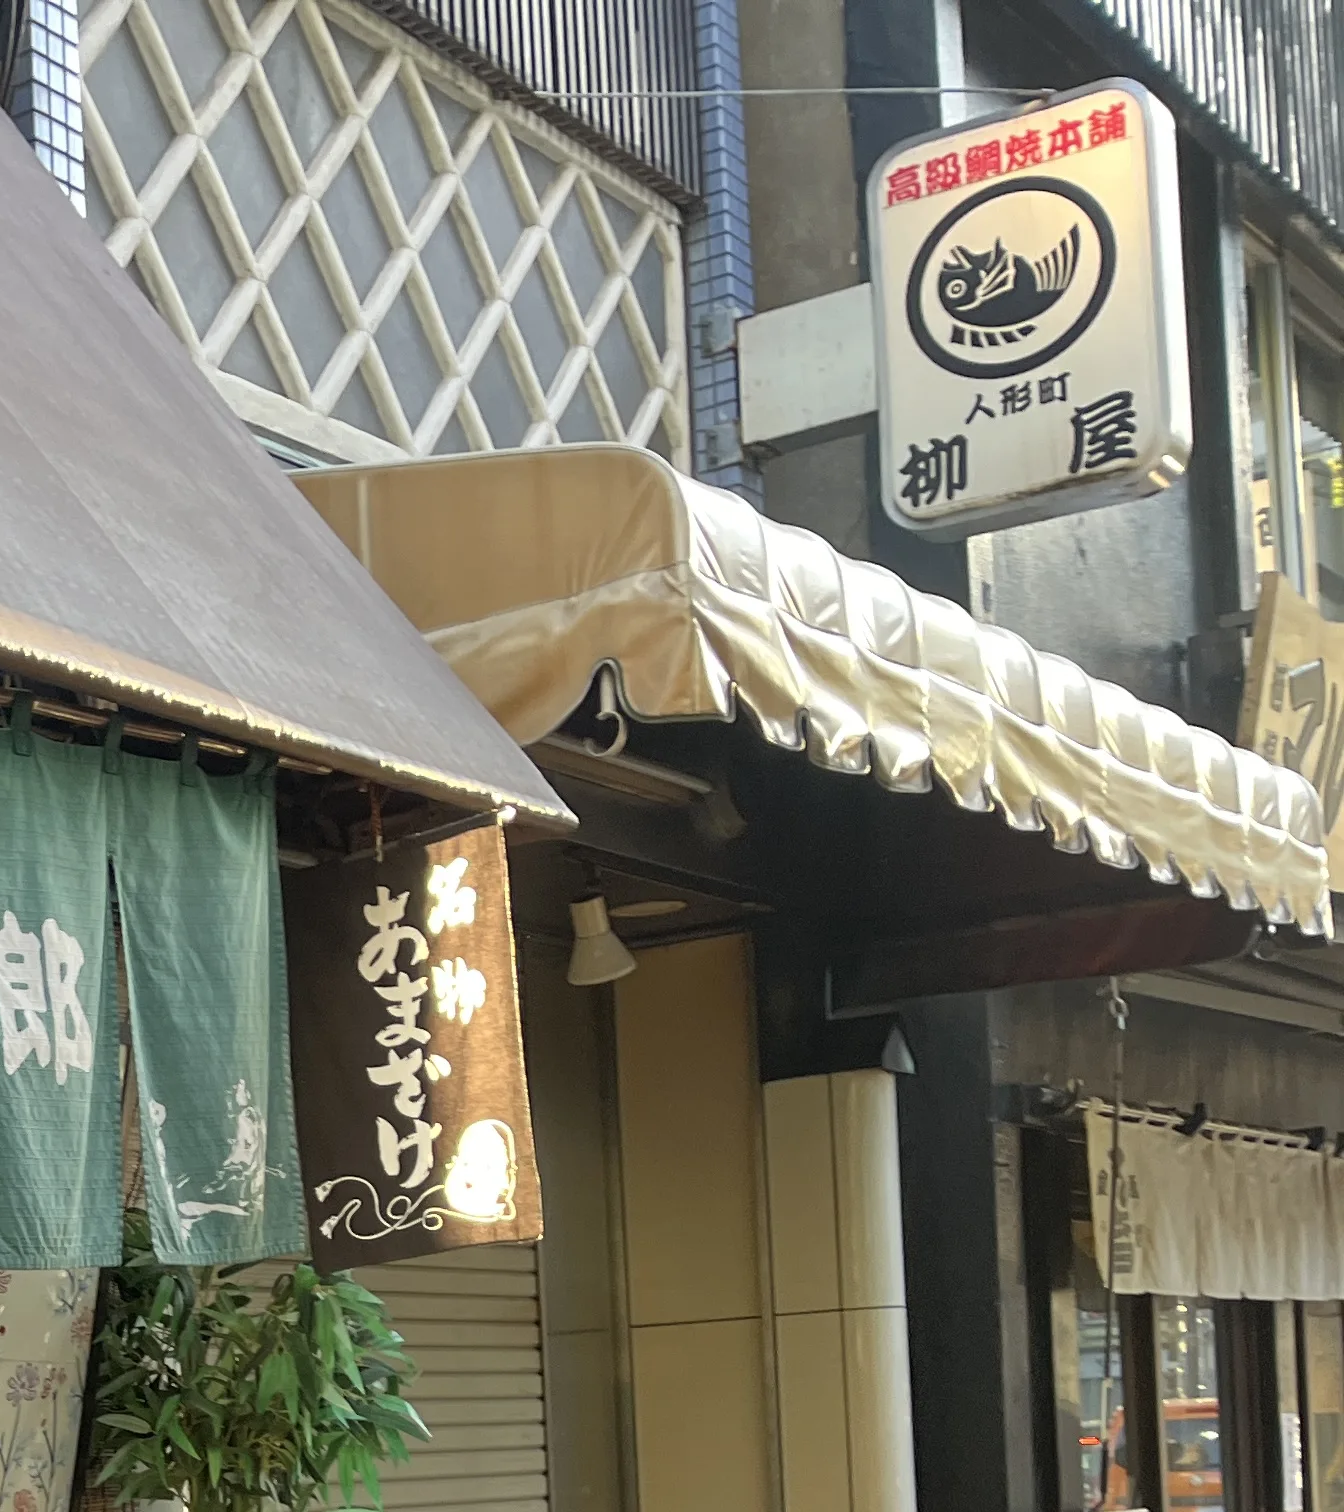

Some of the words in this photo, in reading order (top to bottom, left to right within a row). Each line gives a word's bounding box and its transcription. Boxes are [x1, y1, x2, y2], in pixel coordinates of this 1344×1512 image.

[965, 372, 1073, 424] 人形町
[427, 856, 487, 1024] 名物
[357, 885, 452, 1188] あまざけ
